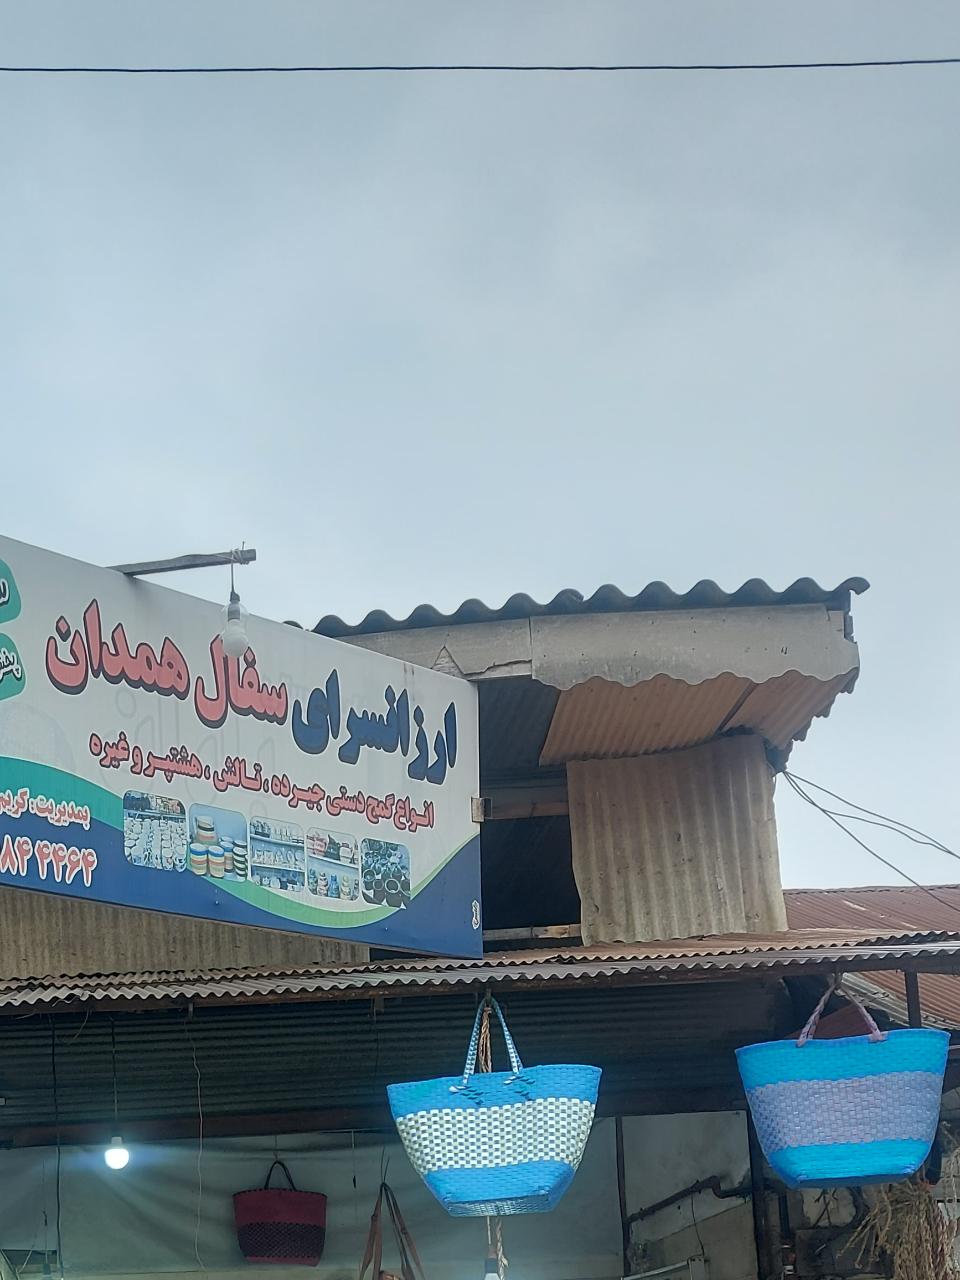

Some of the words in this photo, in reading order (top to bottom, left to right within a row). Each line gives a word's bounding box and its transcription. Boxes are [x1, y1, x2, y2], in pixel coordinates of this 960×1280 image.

[45, 599, 191, 695] همدان
[194, 635, 288, 729] سفال
[292, 669, 457, 785] ارزانسرای
[89, 731, 131, 767] غیره
[132, 746, 143, 775] و
[144, 745, 202, 782] هشتپر
[326, 786, 365, 816] دستی
[393, 795, 434, 832] انواع
[35, 840, 97, 887] ۴۴۶۴
